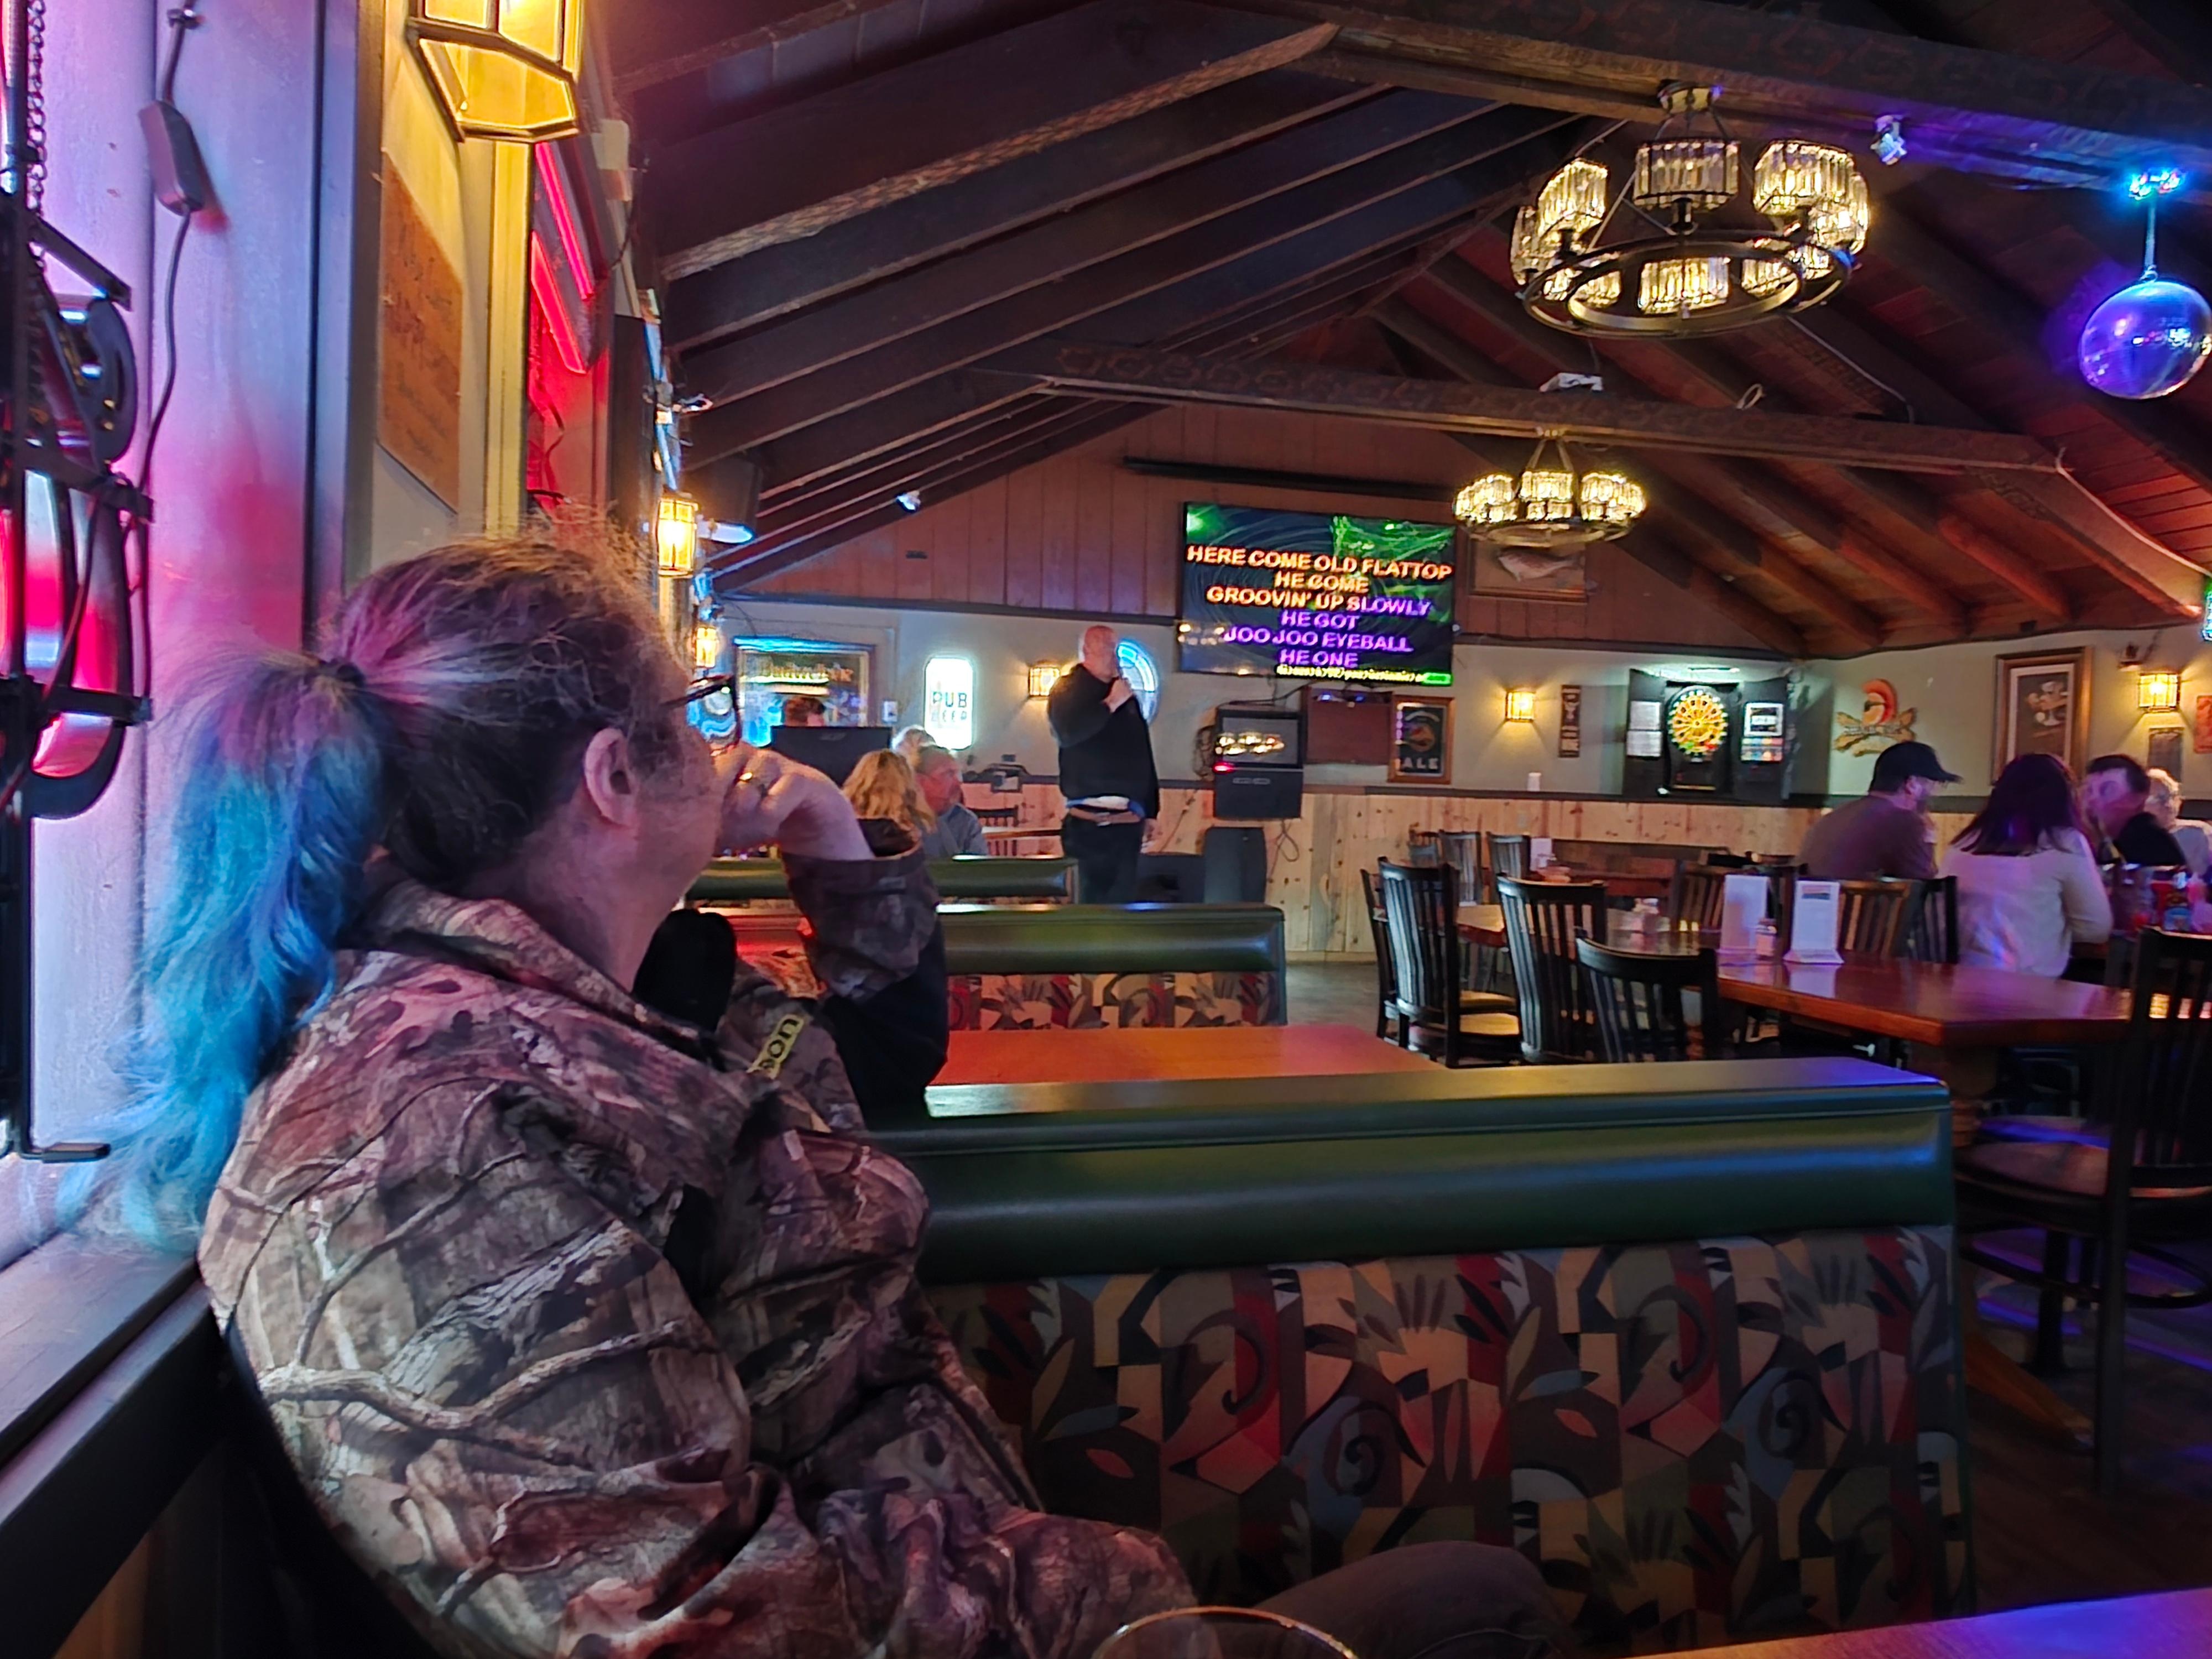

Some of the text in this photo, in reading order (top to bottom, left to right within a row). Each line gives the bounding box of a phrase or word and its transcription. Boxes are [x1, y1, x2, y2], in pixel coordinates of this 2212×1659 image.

[1187, 545, 1453, 580] HERE COME OLD FLATTOP
[1274, 570, 1369, 593] HE COME
[1206, 586, 1432, 616] GROOVIN' UP SLOWLY
[1281, 609, 1360, 630] HE GOT
[1223, 626, 1414, 652] JOO JOO EYEBALL
[1279, 648, 1358, 668] HE ONE
[932, 691, 968, 708] PUB
